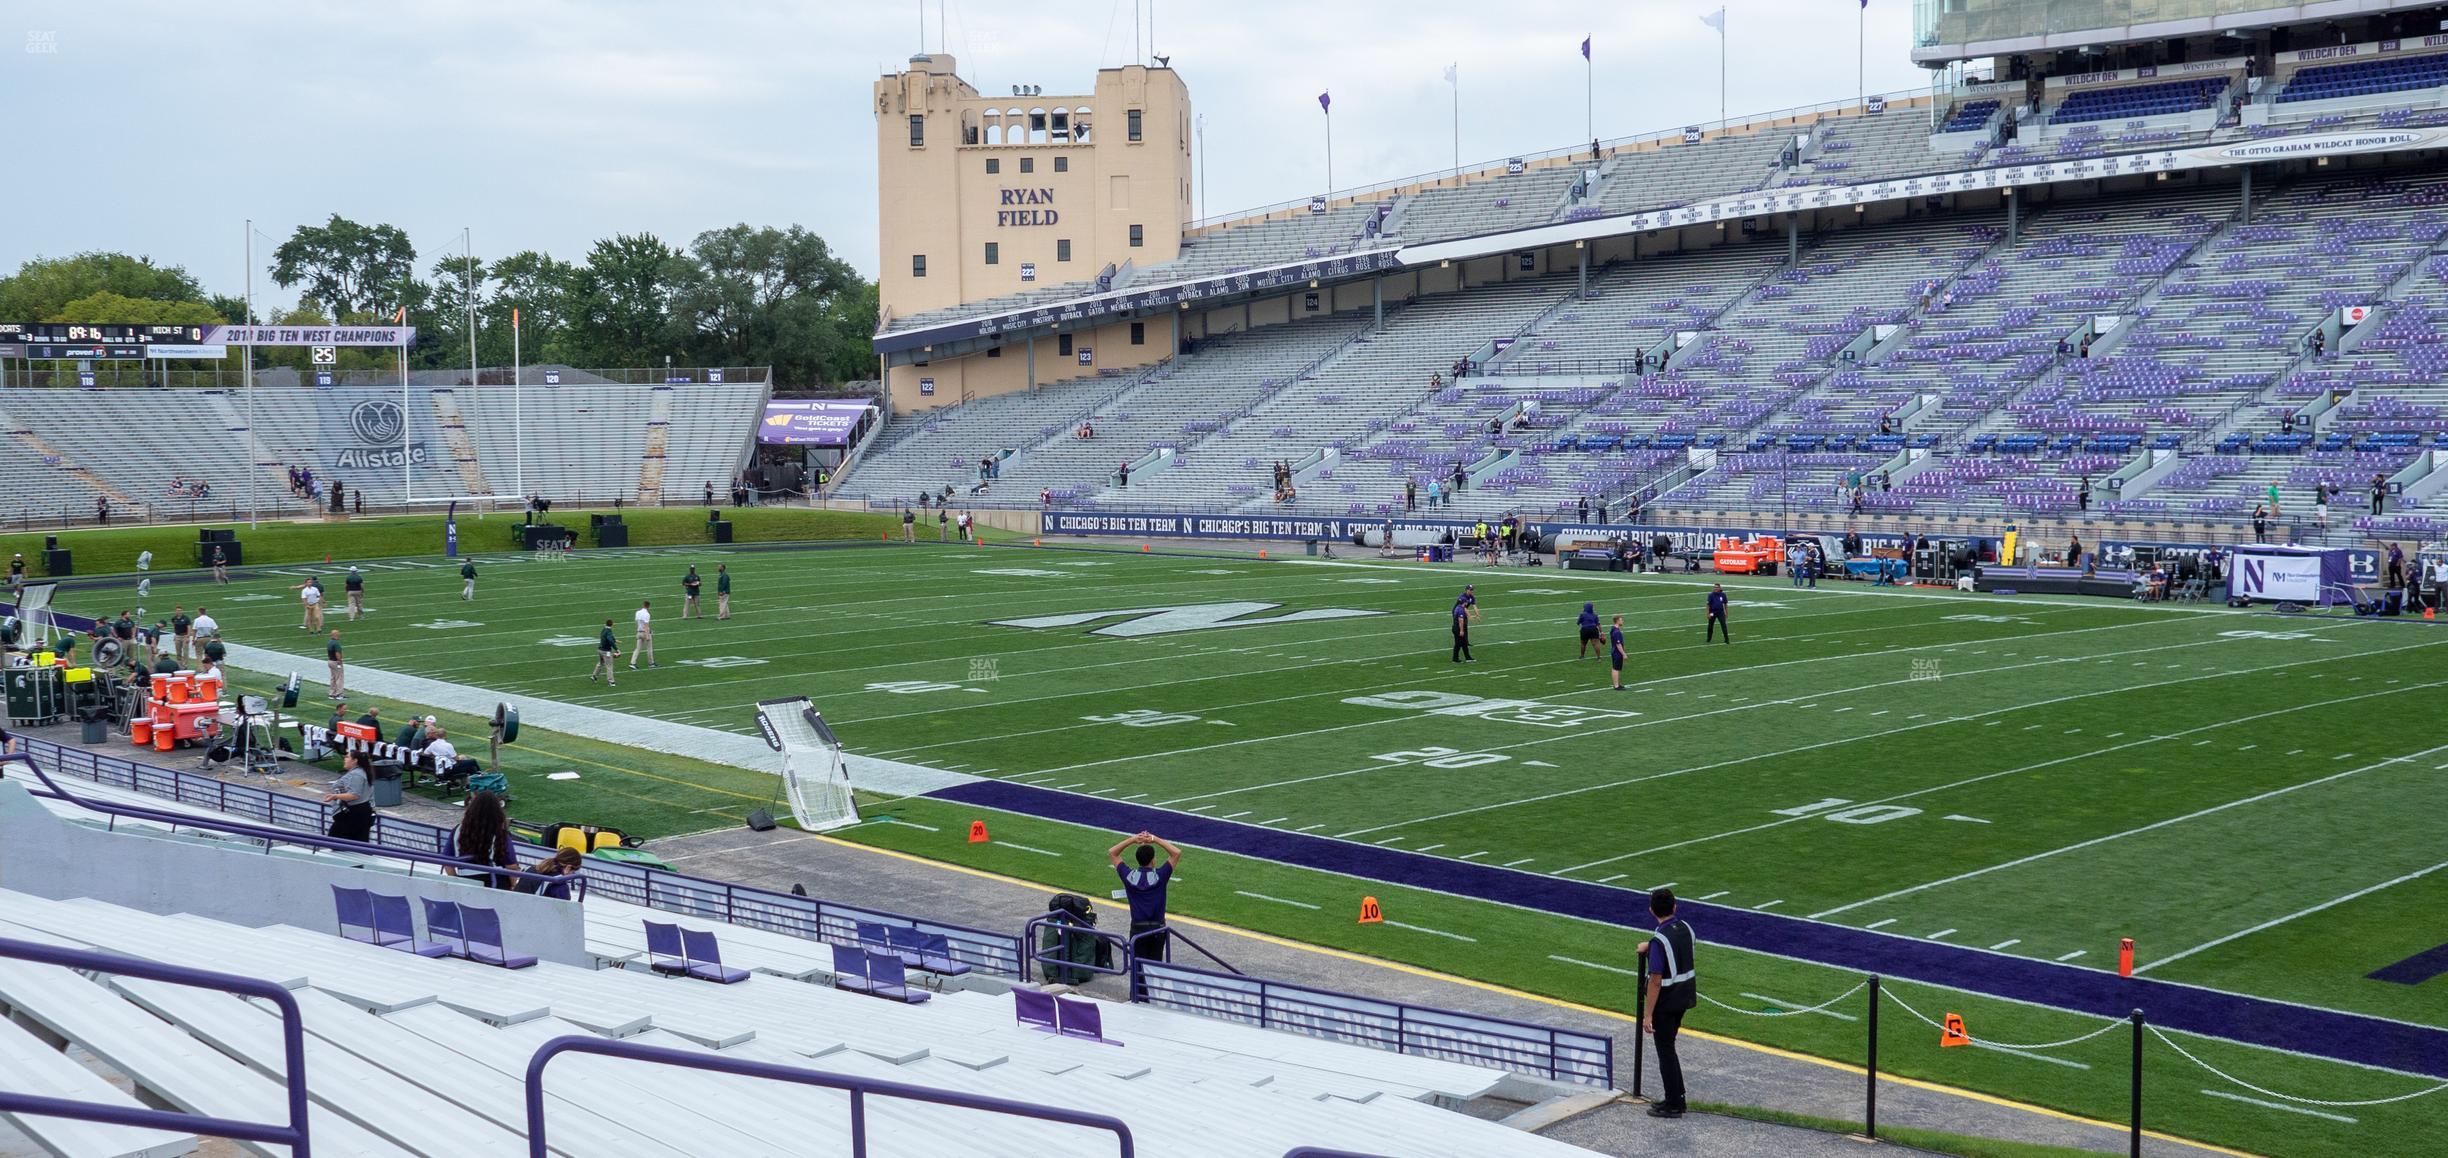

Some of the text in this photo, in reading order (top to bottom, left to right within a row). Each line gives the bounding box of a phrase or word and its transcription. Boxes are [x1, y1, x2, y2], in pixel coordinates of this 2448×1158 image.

[2297, 44, 2357, 61] WILDCAT DEN
[2183, 60, 2228, 71] WINTRUST
[2064, 71, 2118, 86] WILDCAT DEN
[1969, 83, 2011, 94] WINTRUST
[1869, 102, 1882, 111] 227
[2229, 134, 2412, 157] THE OTTO GRAHAM WILDCAT HONOR ROLL
[1510, 163, 1522, 173] 225
[1000, 188, 1054, 206] RYAN
[1312, 201, 1325, 211] 224
[997, 209, 1059, 227] FIELD
[1356, 255, 1370, 263] 1996
[1377, 251, 1392, 260] 1949
[1302, 263, 1318, 272] 2000
[1330, 259, 1344, 267] 1997
[1356, 262, 1371, 271] ROSE
[1022, 268, 1035, 278] 223
[1301, 270, 1320, 279] ALAMO
[1328, 265, 1348, 276] CITRUS
[1257, 274, 1294, 287] MOTOR CITY
[1209, 287, 1229, 296] ALAMO
[1238, 282, 1249, 291] SUN
[1177, 290, 1202, 300] OUTBACK
[1110, 302, 1134, 311] MEINEKE
[1140, 296, 1170, 307] TICKETCITY
[1060, 311, 1082, 320] OUTBACK
[1087, 307, 1105, 316] GATOR
[1002, 320, 1027, 330] MUSIC CITY
[1032, 315, 1054, 325] PINSTRIPE
[69, 326, 102, 340] 89:16
[152, 326, 183, 334] MICH ST
[192, 327, 201, 340] 0
[979, 326, 997, 335] HOLIDAY
[26, 333, 33, 341] 3
[139, 334, 145, 342] 3
[257, 330, 396, 342] BIG TEN WEST CHAMPIONS
[314, 349, 333, 362] 25
[1079, 352, 1091, 362] 123
[547, 374, 560, 383] 120
[710, 373, 721, 381] 121
[922, 382, 933, 392] 122
[811, 402, 826, 411] N
[337, 447, 426, 468] Allstate
[448, 524, 456, 535] N
[1044, 515, 1340, 538] N CHICAGO'S BIG TEN TEAM N CHICAGO'S BIG TEN TEAM N
[1719, 558, 1748, 566] GATORADE
[2244, 559, 2264, 593] N
[1080, 709, 1200, 728] 30
[1369, 746, 1513, 769] 20
[1770, 797, 1923, 826] 10
[973, 825, 984, 837] 20
[1363, 903, 1379, 919] 10
[1948, 1019, 1961, 1038] G
